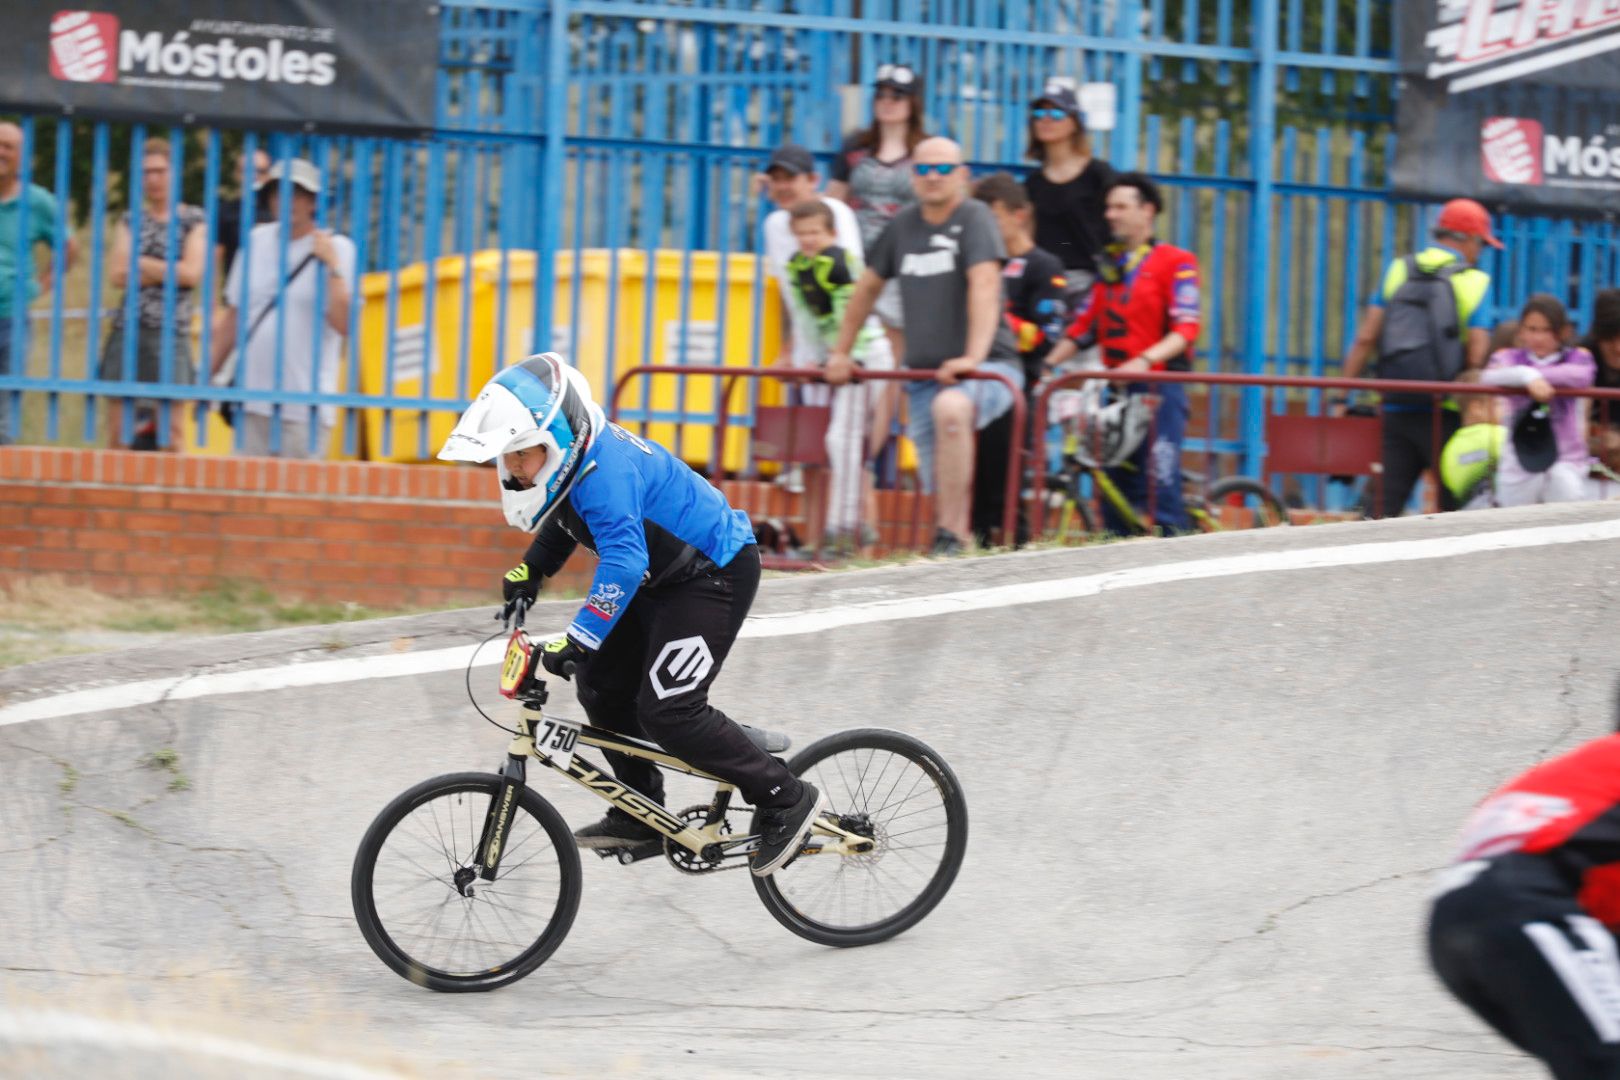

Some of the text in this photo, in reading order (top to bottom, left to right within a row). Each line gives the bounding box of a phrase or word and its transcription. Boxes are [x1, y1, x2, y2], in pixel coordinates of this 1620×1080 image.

[118, 29, 338, 86] Móstoles
[539, 720, 579, 753] 750
[569, 754, 689, 835] HASE
